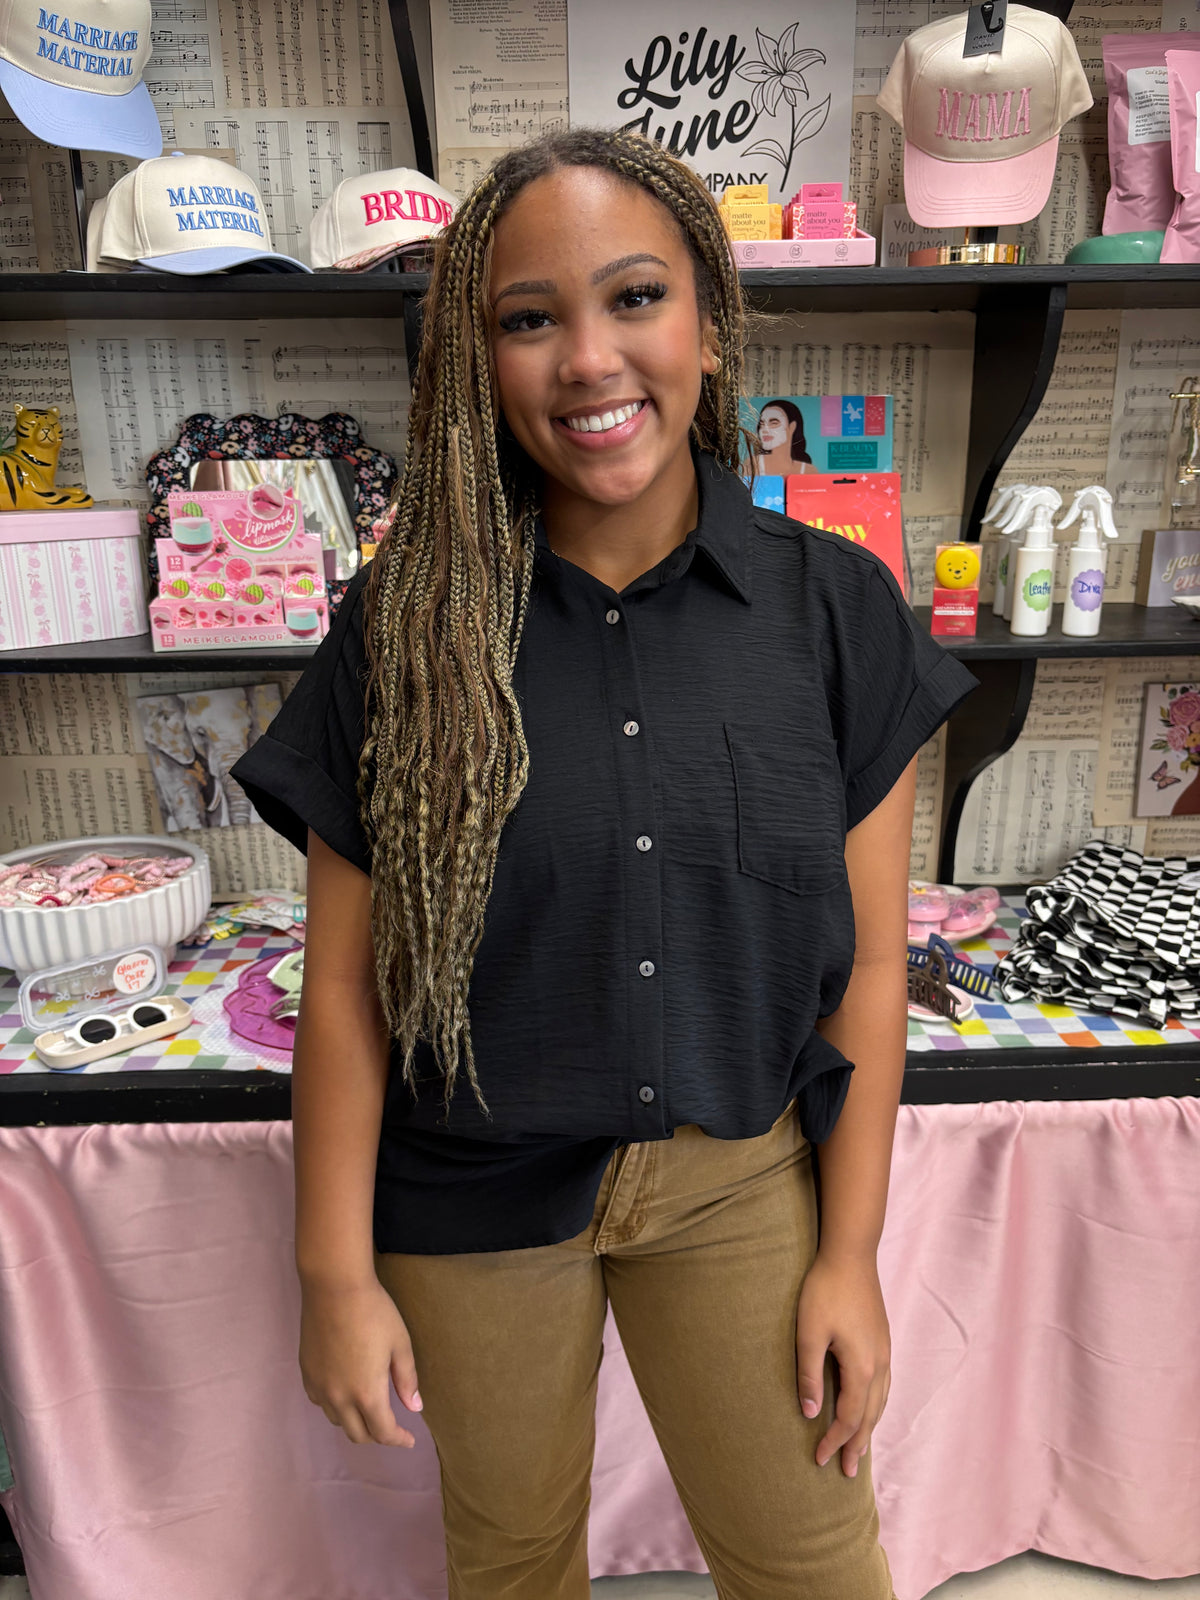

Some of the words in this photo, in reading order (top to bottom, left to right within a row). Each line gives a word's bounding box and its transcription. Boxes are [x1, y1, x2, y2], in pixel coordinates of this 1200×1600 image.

[36, 7, 139, 52] MARRIAGE
[36, 35, 134, 77] MATERIAL
[617, 26, 746, 110] Lily
[935, 85, 1032, 143] MAMA
[696, 172, 768, 193] MPANY
[166, 185, 259, 214] MARRIAGE
[175, 209, 264, 238] MATERIAL
[731, 218, 751, 226] about
[752, 219, 766, 227] you
[806, 217, 826, 225] about
[827, 218, 841, 226] you
[894, 220, 916, 234] YOU
[170, 557, 181, 566] 12
[183, 637, 222, 645] MEIKE
[224, 634, 282, 643] GLAMOUR
